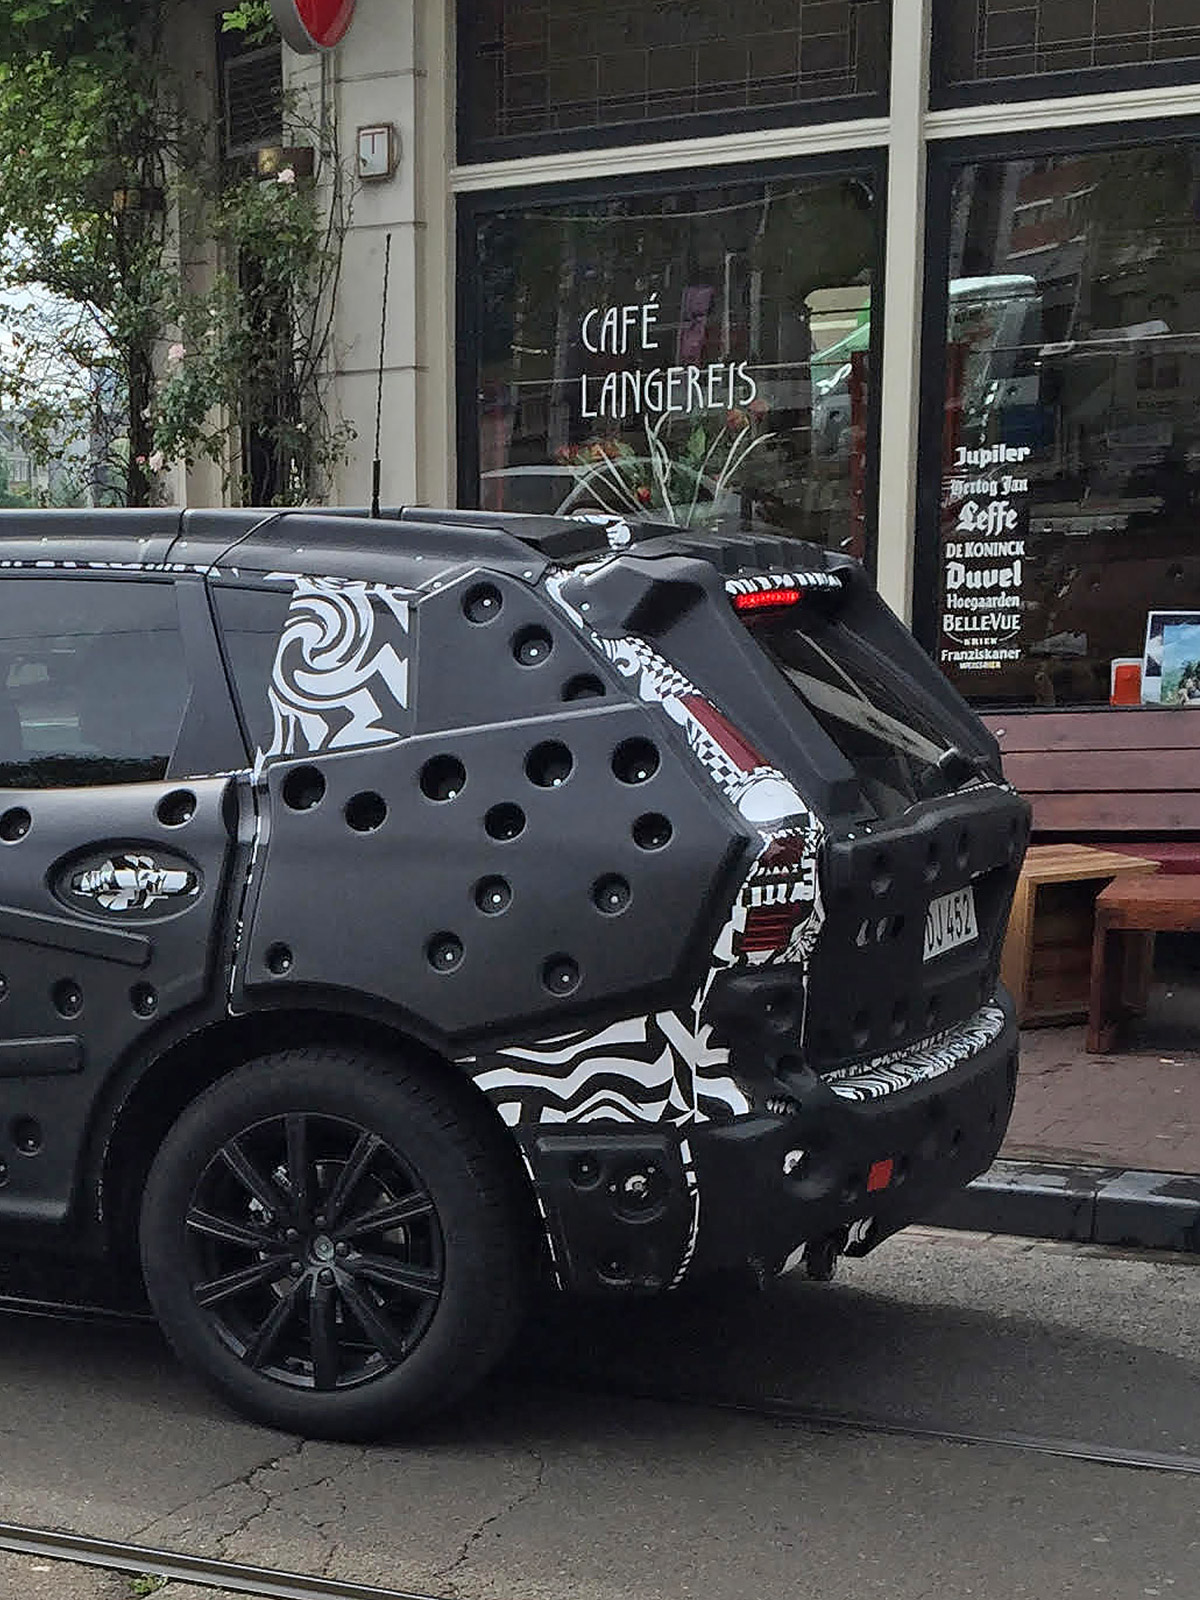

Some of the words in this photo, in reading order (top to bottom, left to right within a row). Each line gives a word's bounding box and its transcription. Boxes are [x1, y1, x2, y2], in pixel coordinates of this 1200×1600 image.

[582, 292, 659, 354] CAFÉ
[582, 361, 757, 419] LANGEREIS
[953, 443, 1030, 468] Jupiler
[1001, 475, 1028, 495] Jan
[955, 500, 1018, 536] Leffe
[964, 541, 1025, 558] KONINCK
[945, 560, 1022, 590] Duvel
[946, 591, 1020, 611] Hoegaarden
[941, 649, 1021, 661] Franziskaner
